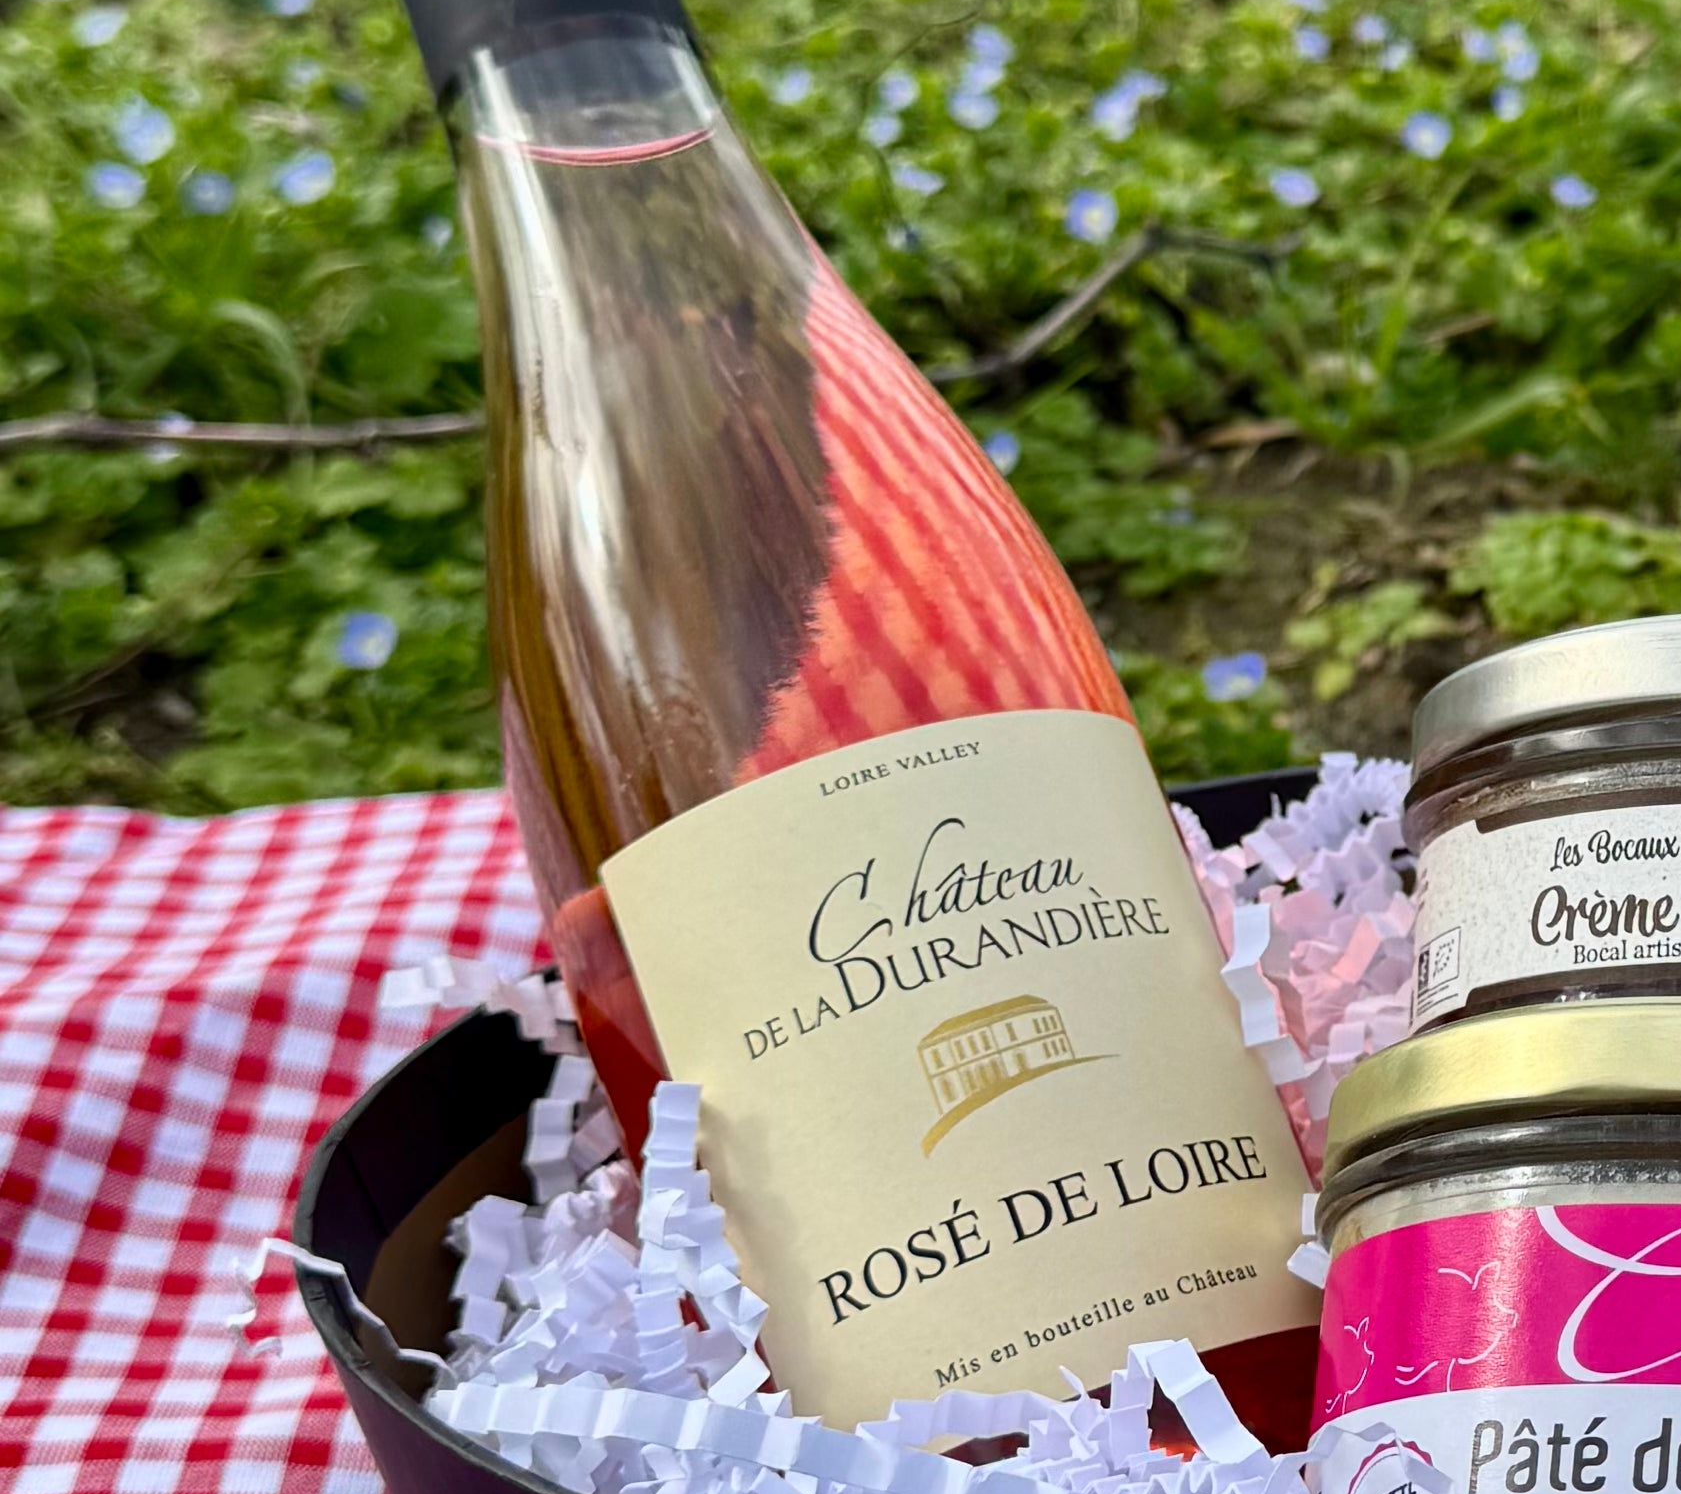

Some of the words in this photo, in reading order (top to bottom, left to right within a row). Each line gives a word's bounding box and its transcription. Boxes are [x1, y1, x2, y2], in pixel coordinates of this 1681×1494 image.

[819, 762, 890, 796] LOIRE
[896, 741, 982, 771] VALLEY
[808, 817, 1084, 963] Château
[1549, 836, 1582, 872] Les
[1588, 829, 1680, 864] Bocaux
[1531, 885, 1679, 947] Crème
[1572, 938, 1629, 966] Bocal
[743, 1016, 789, 1060] DE
[800, 998, 840, 1034] LA
[833, 886, 1170, 1012] DURANDIÈRE
[818, 1199, 992, 1324] ROSÉ
[998, 1171, 1099, 1244] DE
[1105, 1136, 1268, 1209] LOIRE
[933, 1352, 982, 1388] Mis
[990, 1342, 1019, 1366] en
[1025, 1295, 1135, 1350] bouteille
[1141, 1284, 1170, 1307] au
[1176, 1261, 1258, 1299] Château
